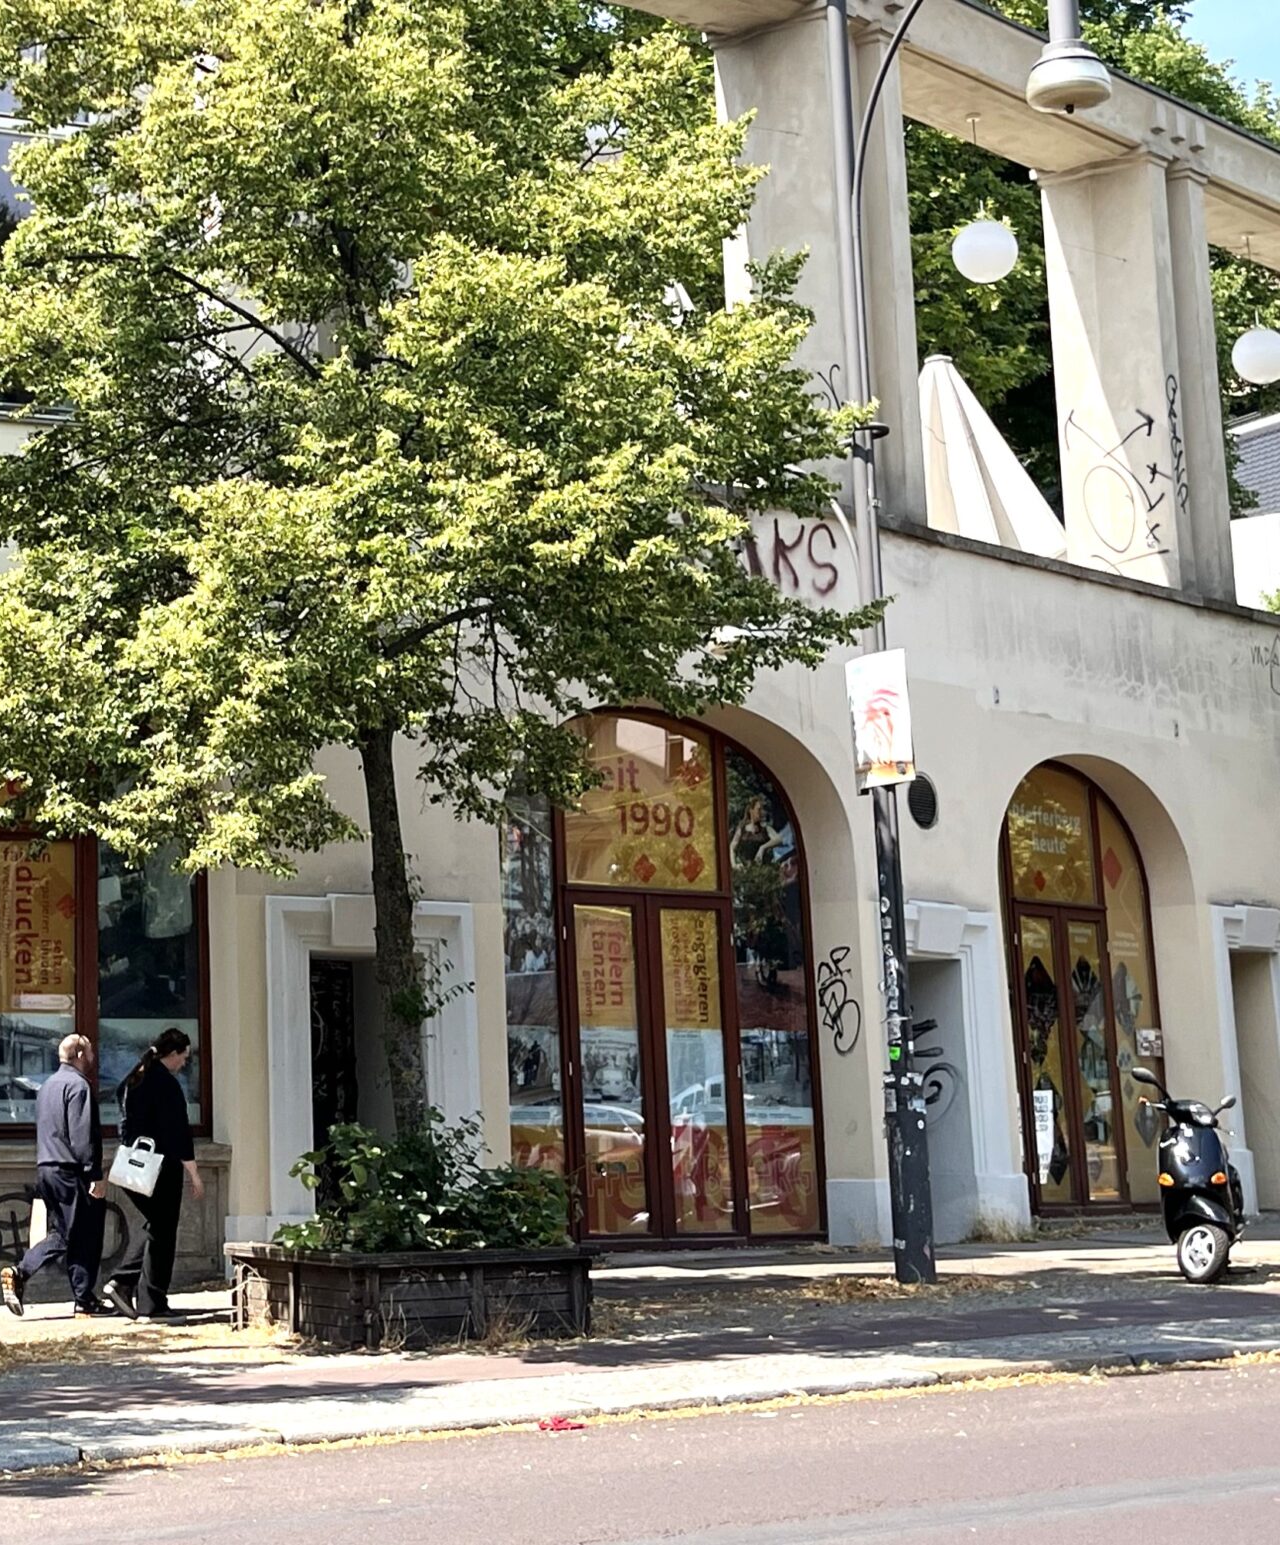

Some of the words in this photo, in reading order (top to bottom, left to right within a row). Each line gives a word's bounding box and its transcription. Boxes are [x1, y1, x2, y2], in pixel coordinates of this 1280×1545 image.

[599, 757, 640, 793] eit
[616, 801, 695, 838] 1990
[1011, 803, 1082, 836] Pfefferberg
[1032, 832, 1067, 854] heute
[15, 866, 39, 985] drucken
[592, 930, 606, 1006] tanzen
[608, 931, 628, 1006] feiern
[692, 919, 711, 1023] engagieren
